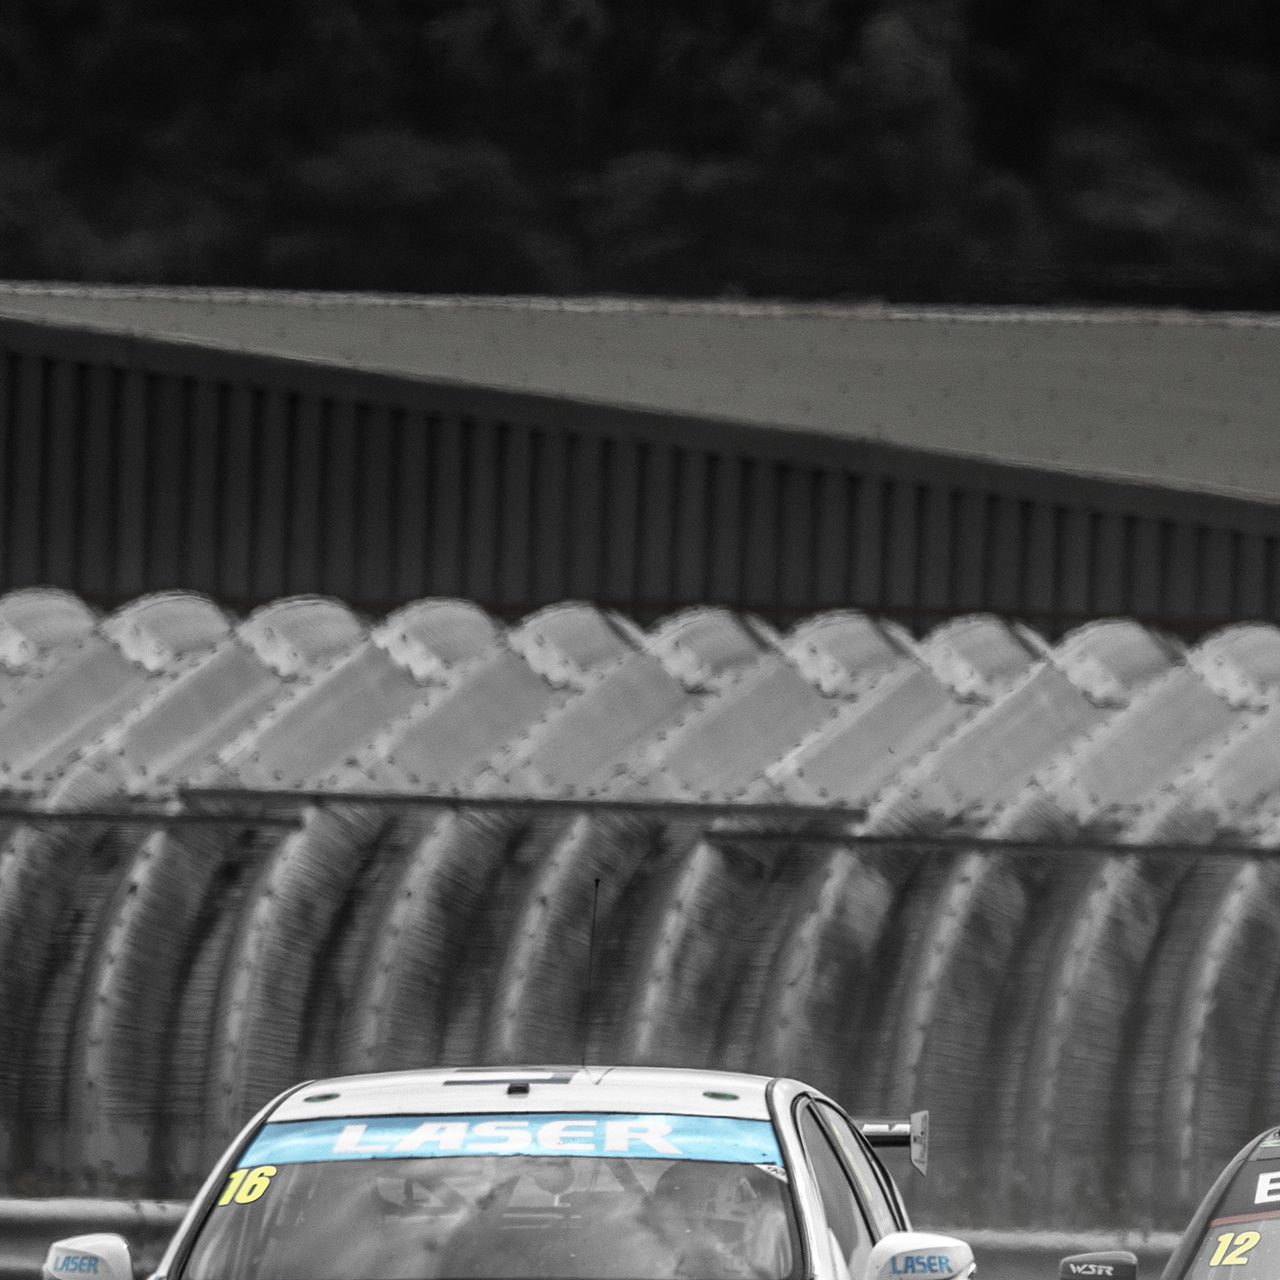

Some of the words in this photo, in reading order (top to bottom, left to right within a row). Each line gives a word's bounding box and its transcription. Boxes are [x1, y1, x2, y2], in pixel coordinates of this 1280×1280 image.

[332, 1119, 683, 1155] LASER
[218, 1166, 277, 1207] 16
[1209, 1231, 1261, 1267] 12
[53, 1255, 99, 1274] LASER
[890, 1255, 953, 1275] LASER
[1069, 1263, 1114, 1277] WSR
